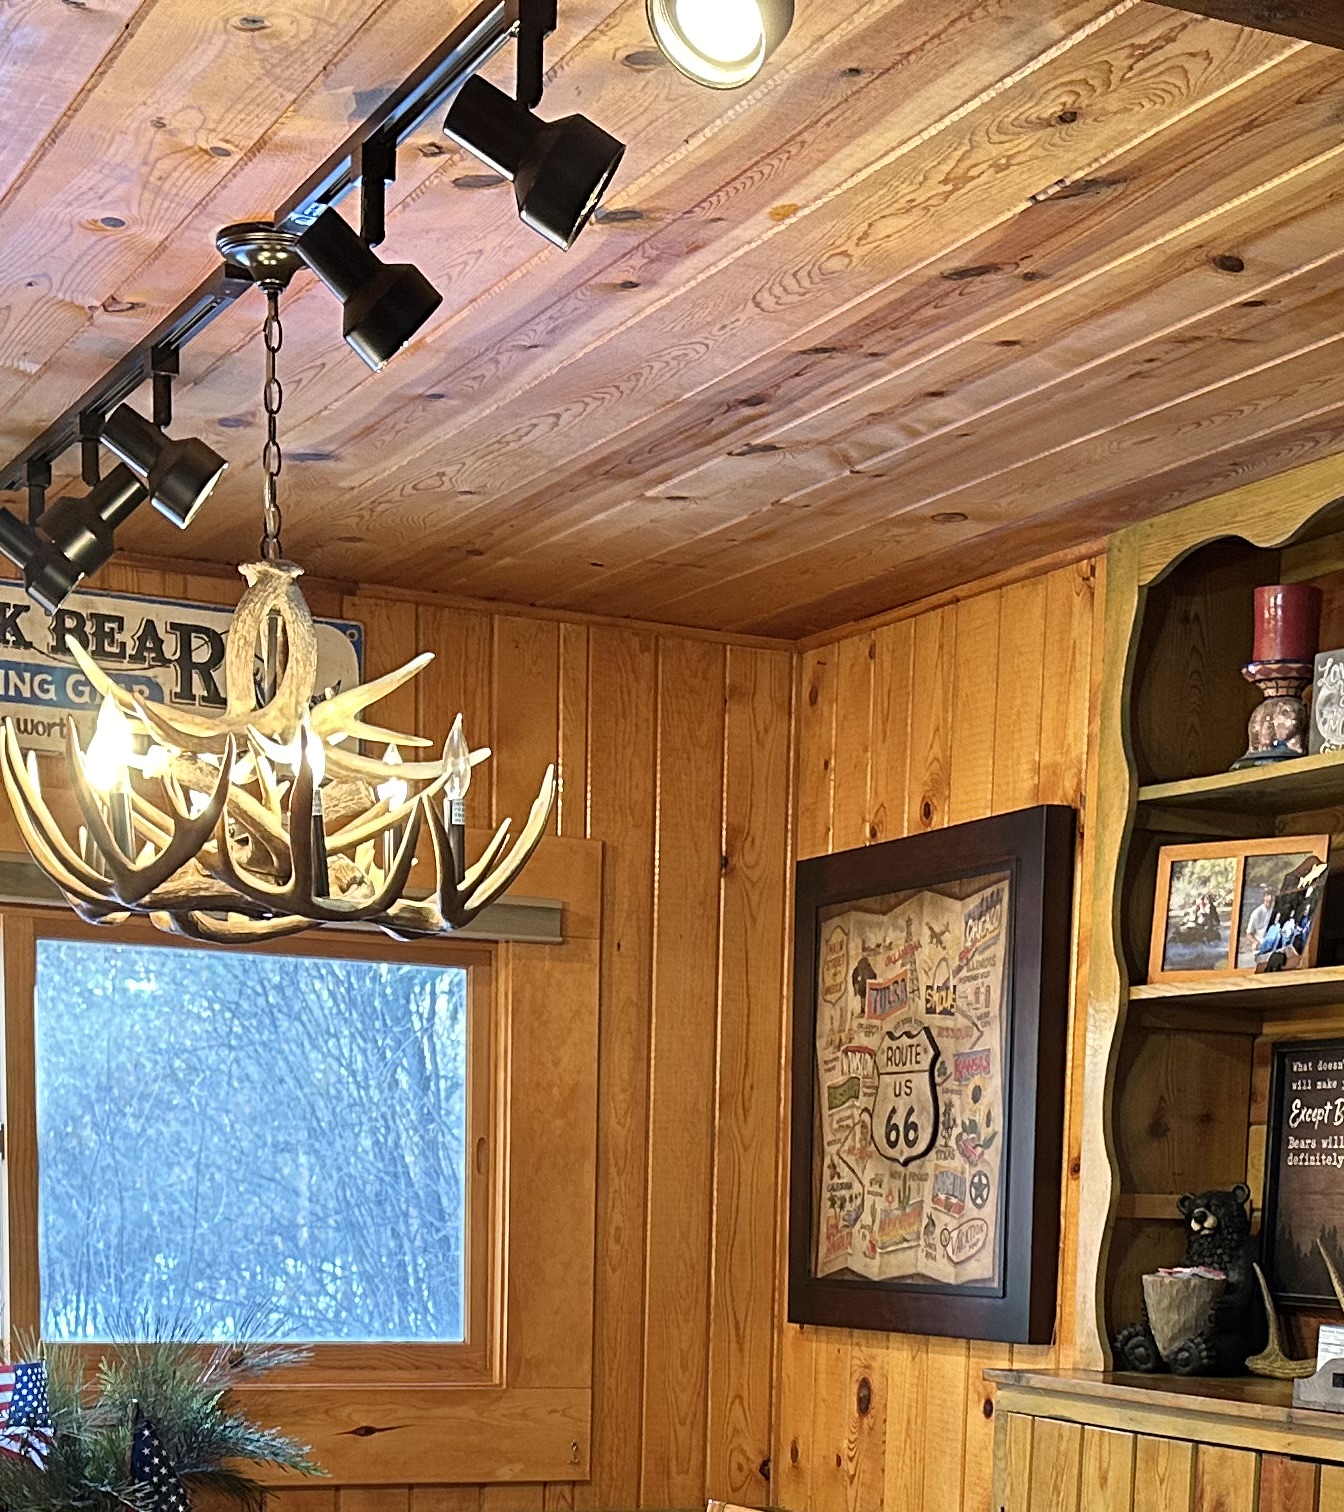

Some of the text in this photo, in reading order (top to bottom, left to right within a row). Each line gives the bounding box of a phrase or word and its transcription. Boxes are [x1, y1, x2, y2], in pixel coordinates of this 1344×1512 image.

[50, 607, 228, 709] BEAR
[66, 673, 150, 705] GR
[16, 715, 68, 739] wort
[886, 1044, 921, 1067] ROUTE
[1292, 1061, 1313, 1072] What
[893, 1080, 913, 1097] US
[1291, 1079, 1312, 1091] will
[1316, 1078, 1338, 1090] make
[1288, 1098, 1333, 1130] Except
[885, 1105, 919, 1149] 66
[1287, 1135, 1344, 1150] Bears will
[1287, 1152, 1344, 1169] definitely
